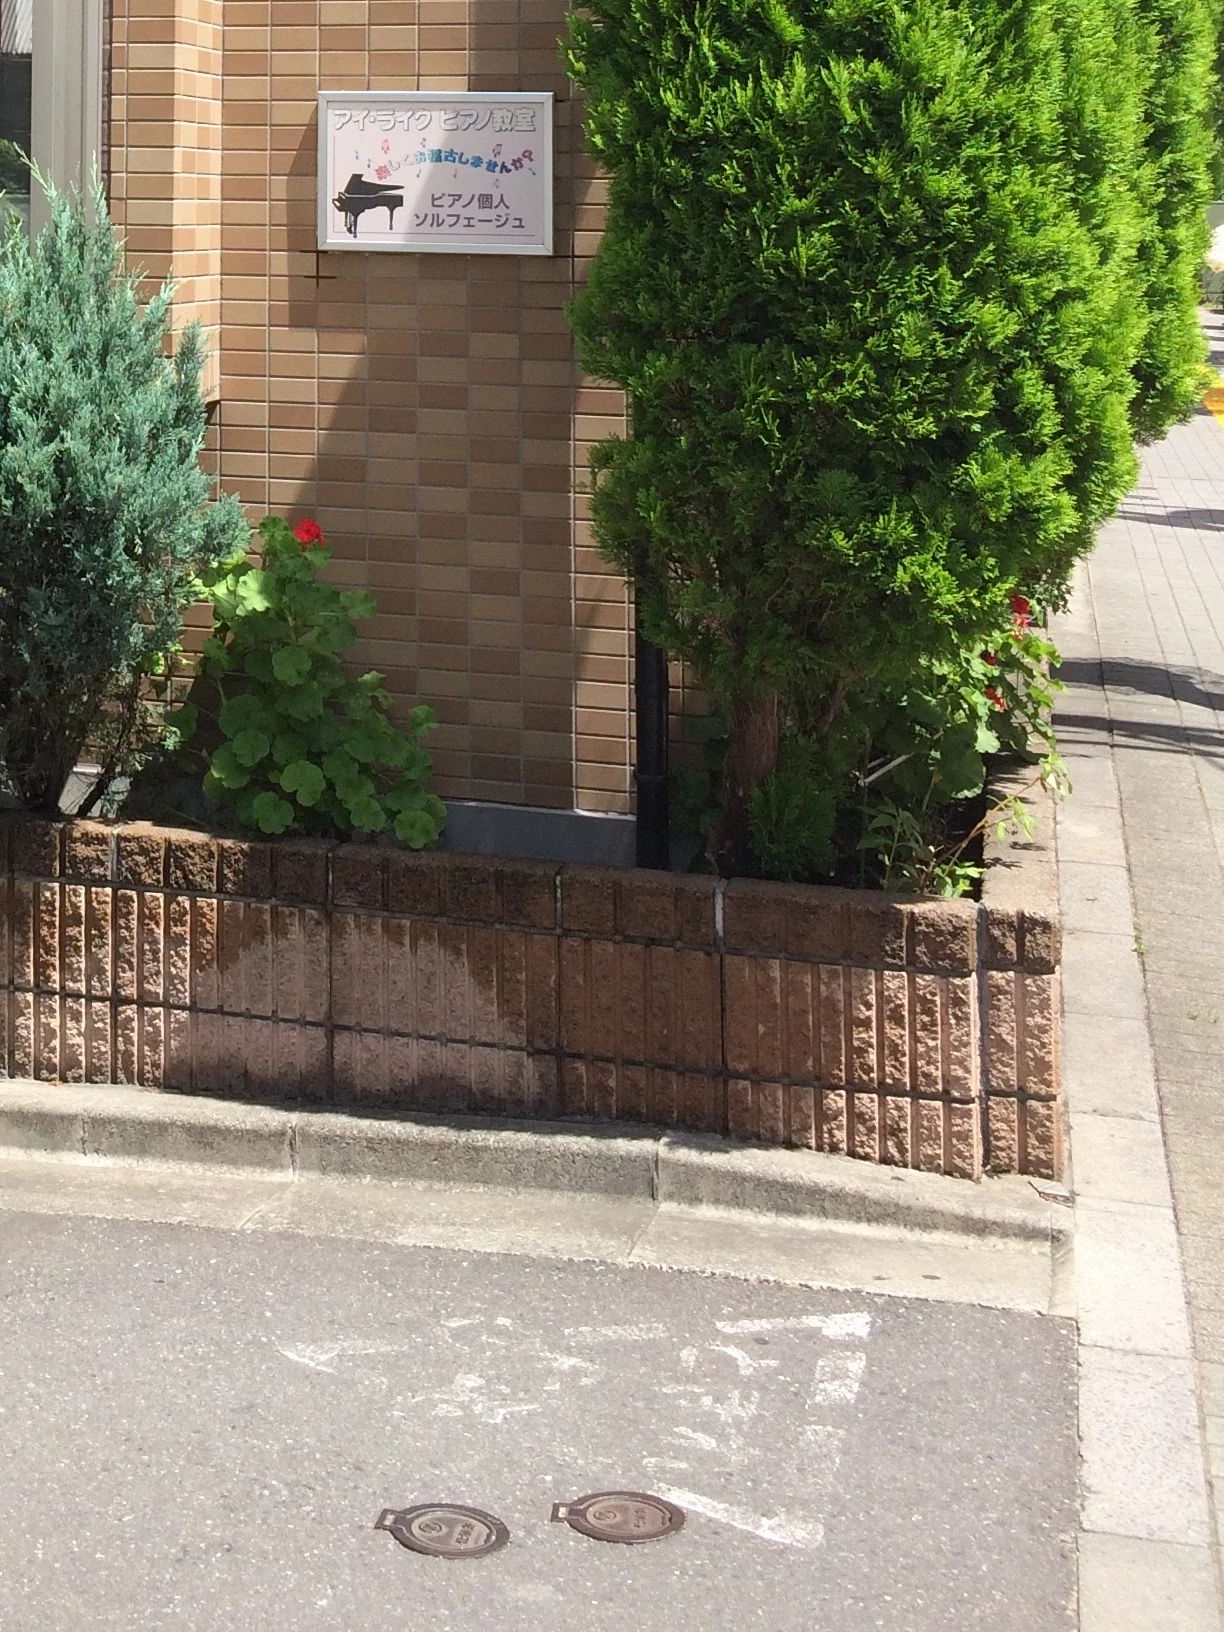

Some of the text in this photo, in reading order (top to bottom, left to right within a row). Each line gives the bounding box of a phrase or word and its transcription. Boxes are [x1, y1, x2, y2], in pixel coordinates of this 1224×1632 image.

[431, 193, 510, 209] ピアノ個人
[414, 213, 525, 229] ソルフェージュ
